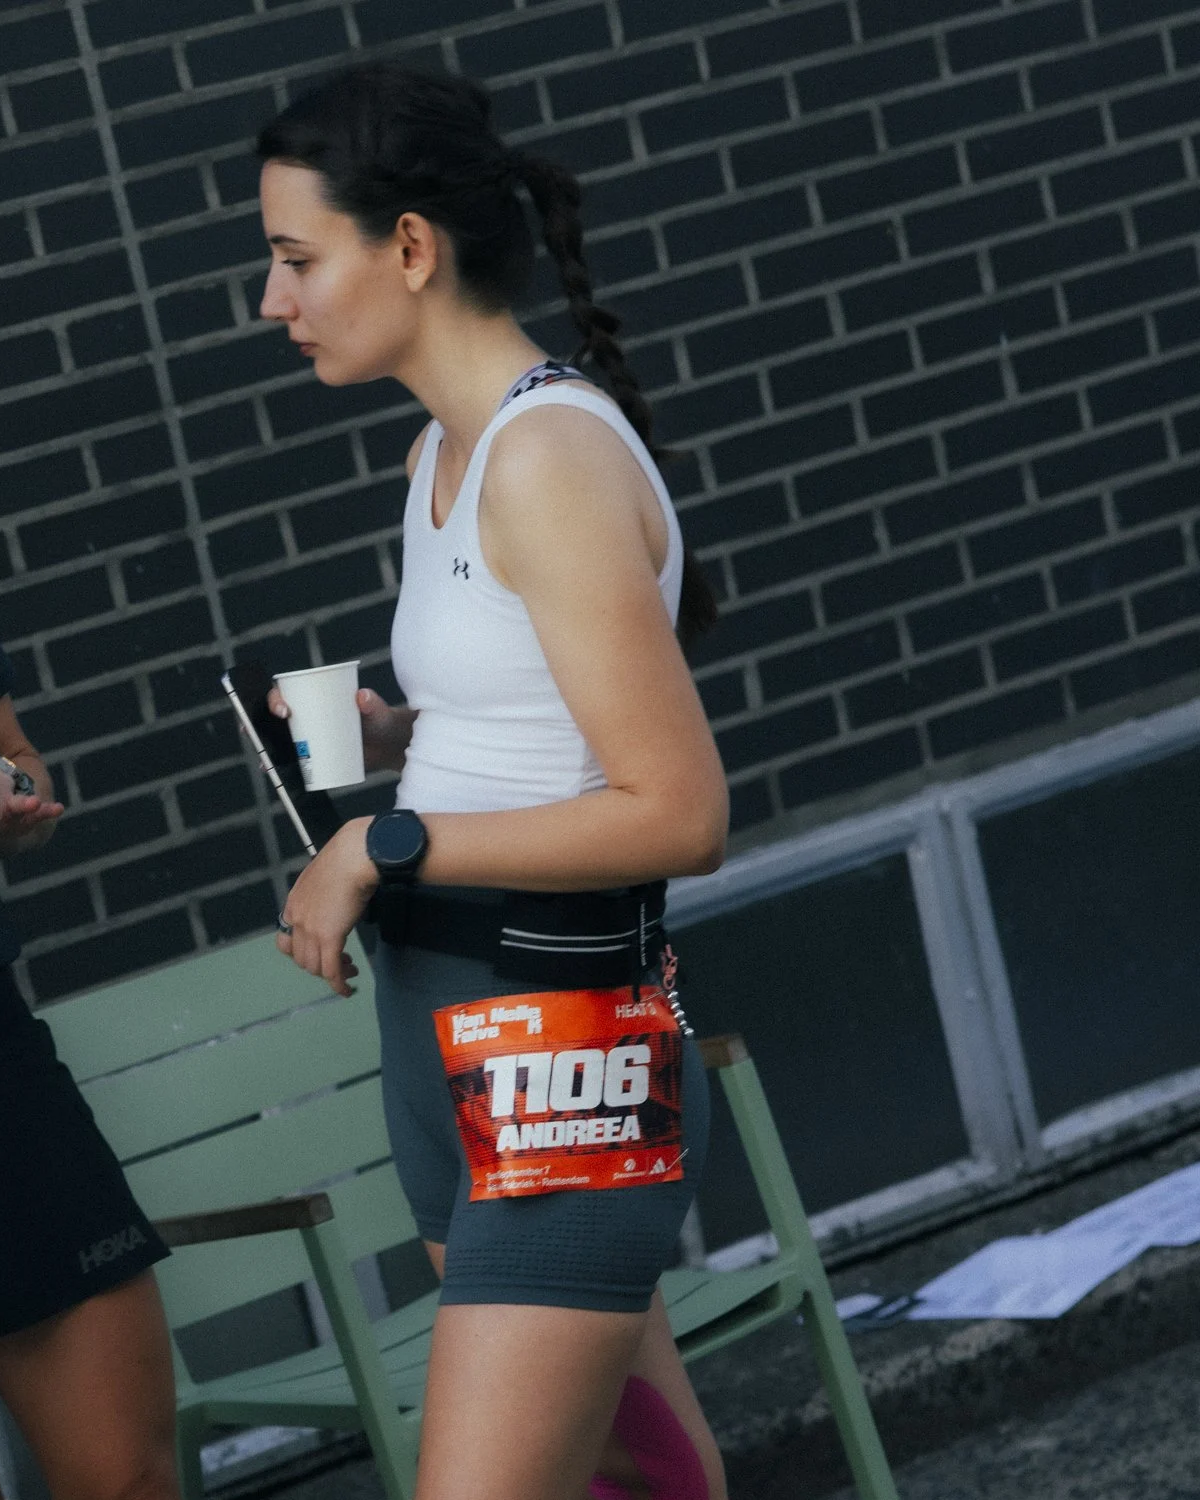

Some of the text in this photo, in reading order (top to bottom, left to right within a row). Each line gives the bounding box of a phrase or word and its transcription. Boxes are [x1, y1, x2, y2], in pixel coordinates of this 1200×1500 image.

[614, 1003, 647, 1019] HEAT
[483, 1044, 652, 1119] 1106
[495, 1114, 641, 1153] ANDREEA
[78, 1224, 149, 1275] HOKA
